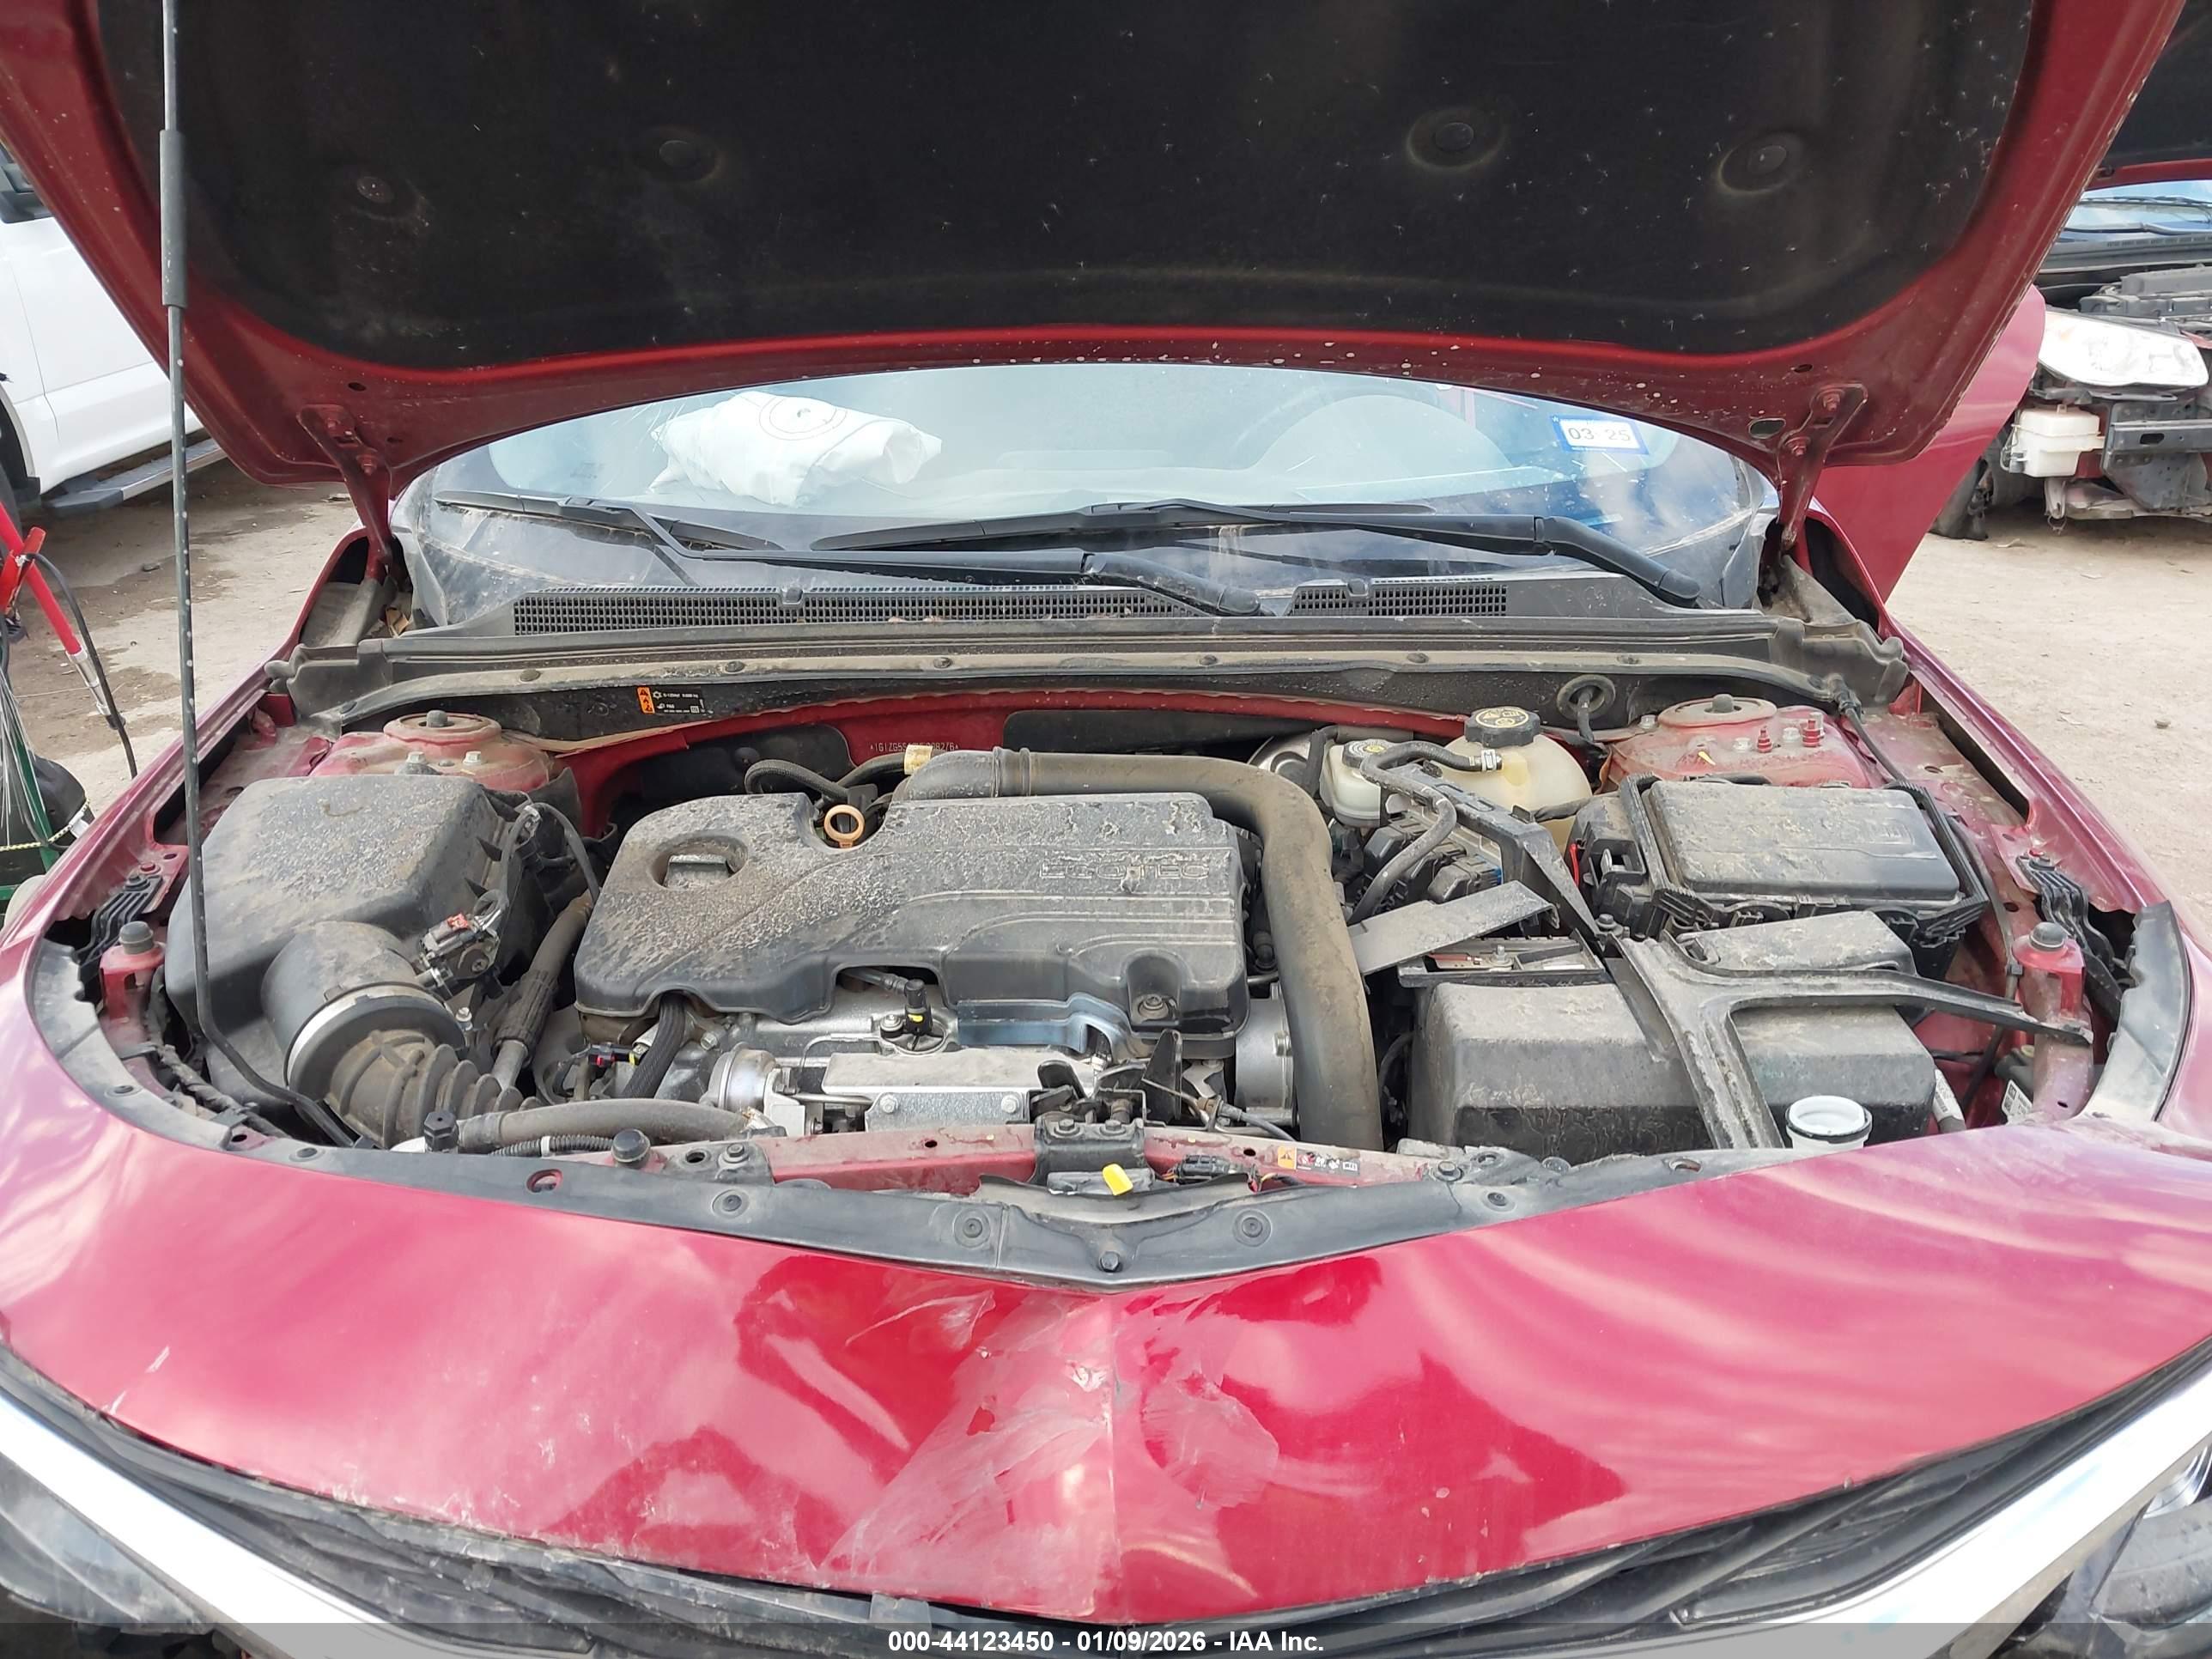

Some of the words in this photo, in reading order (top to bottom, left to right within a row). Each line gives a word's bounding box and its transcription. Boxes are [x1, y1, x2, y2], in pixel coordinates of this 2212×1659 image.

[1568, 428, 1595, 440] 03
[1604, 429, 1630, 441] 25
[1040, 863, 1209, 879] ECOTEC
